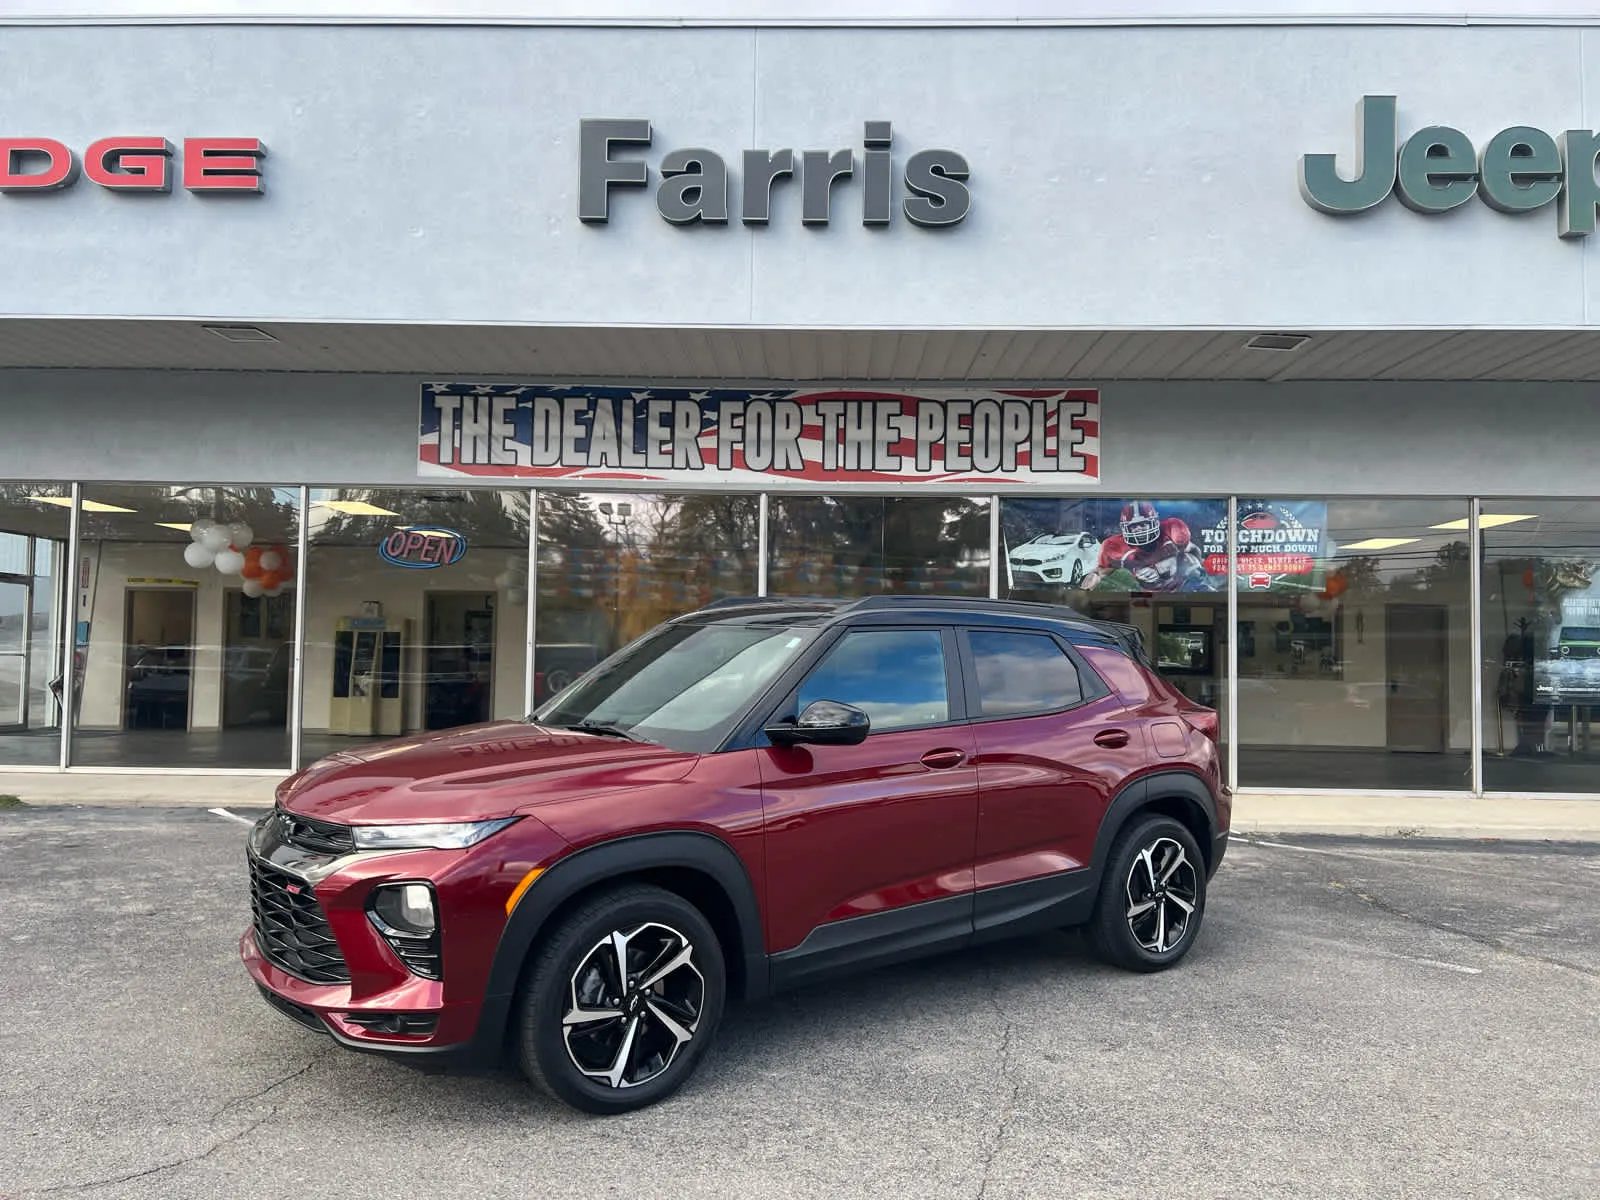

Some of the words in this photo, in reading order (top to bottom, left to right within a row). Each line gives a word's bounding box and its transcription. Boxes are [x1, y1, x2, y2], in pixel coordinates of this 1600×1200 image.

[578, 117, 971, 226] Farris
[433, 394, 518, 466] THE
[531, 396, 704, 470] DEALER
[717, 398, 804, 471] FOR
[816, 399, 903, 472] THE
[915, 399, 1087, 472] PEOPLE
[386, 530, 458, 565] OPEN
[1202, 529, 1319, 543] TOCHDOWN
[1203, 545, 1223, 553] FOR
[1250, 545, 1280, 553] MUCH
[1284, 545, 1318, 553] DOWN!
